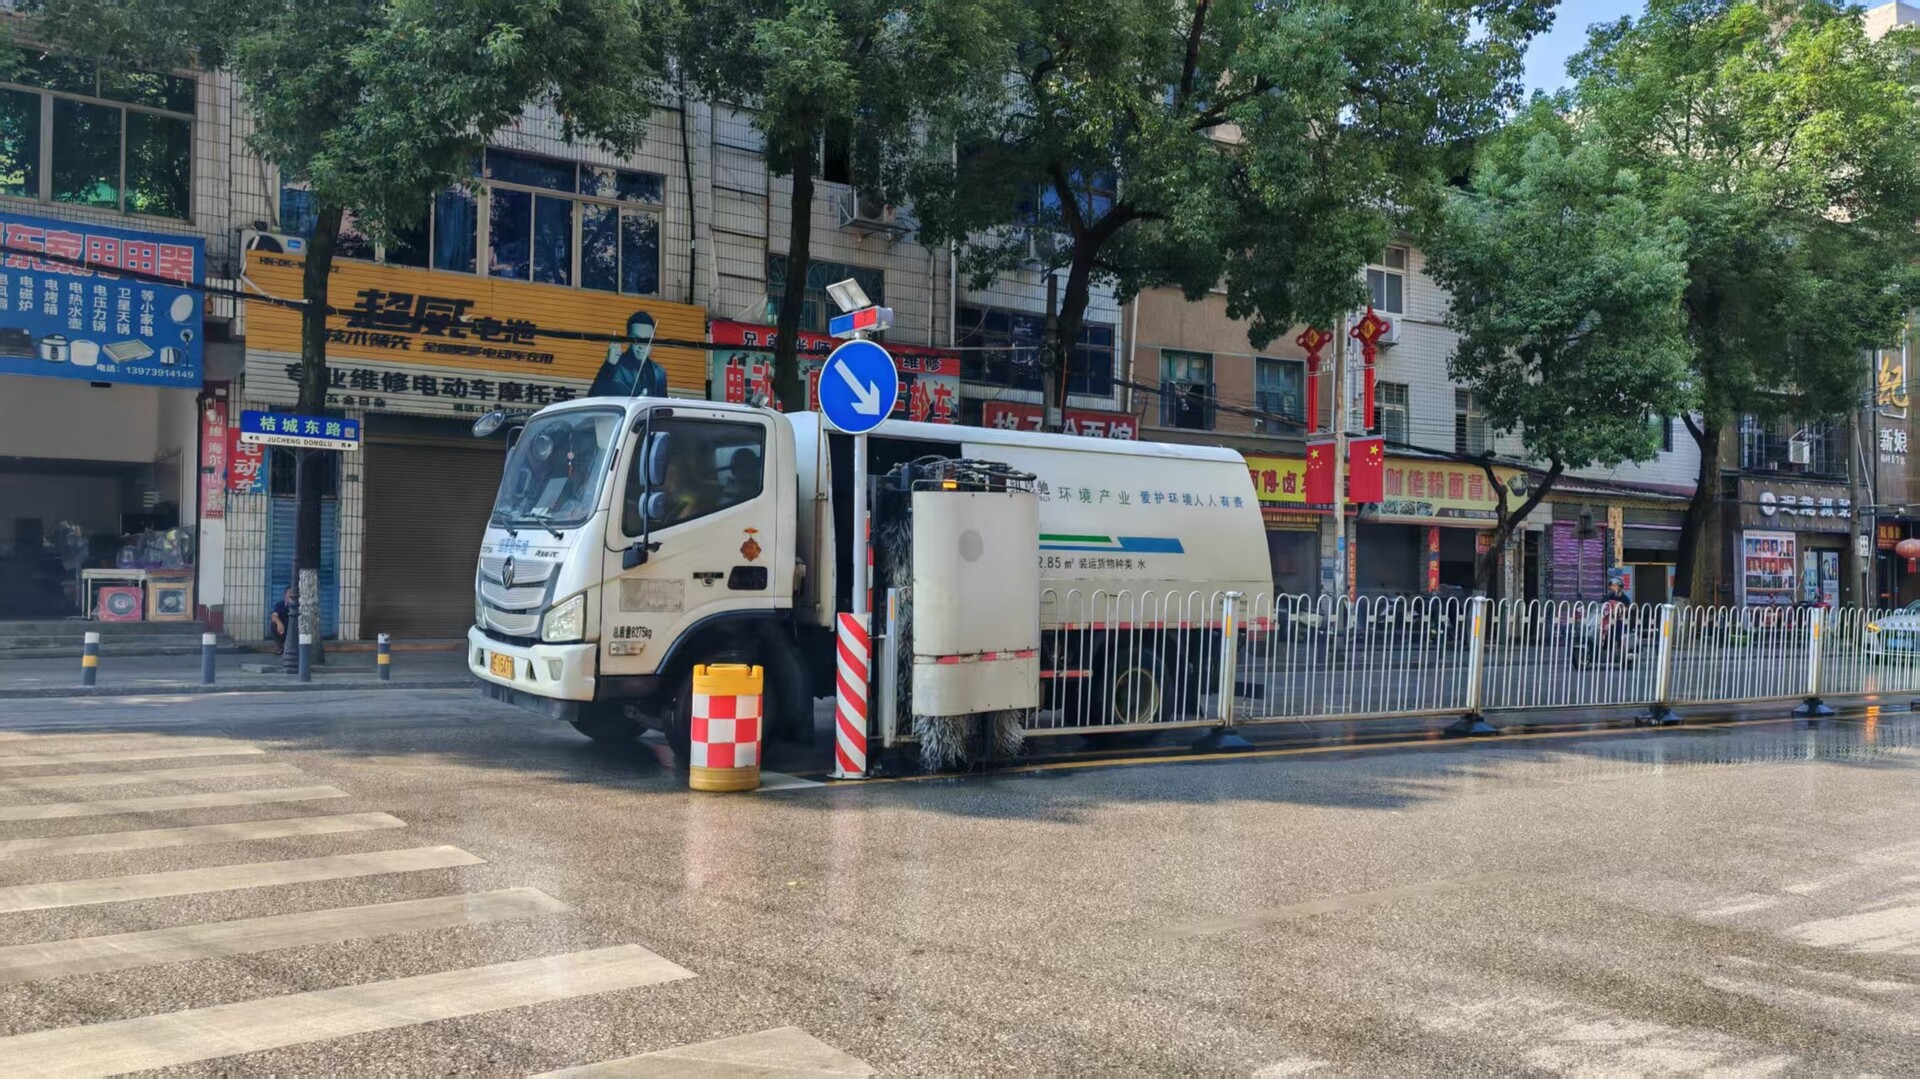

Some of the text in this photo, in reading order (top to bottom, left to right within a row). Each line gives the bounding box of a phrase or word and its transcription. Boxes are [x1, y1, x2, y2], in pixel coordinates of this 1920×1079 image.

[0, 222, 194, 288] 东家用电器
[19, 275, 33, 312] 电磁炉
[43, 278, 58, 316] 电烤箱
[67, 281, 83, 330] 电热水壶
[92, 284, 109, 334] 电压力锅
[116, 287, 131, 336] 卫星天锅
[140, 290, 155, 337] 等小家电
[259, 415, 342, 437] 桔城东路
[267, 437, 301, 445] JUCHENG
[303, 440, 333, 448] DONGLU
[1057, 486, 1132, 506] 环境产业
[1140, 490, 1245, 508] 爱护环境人人有责
